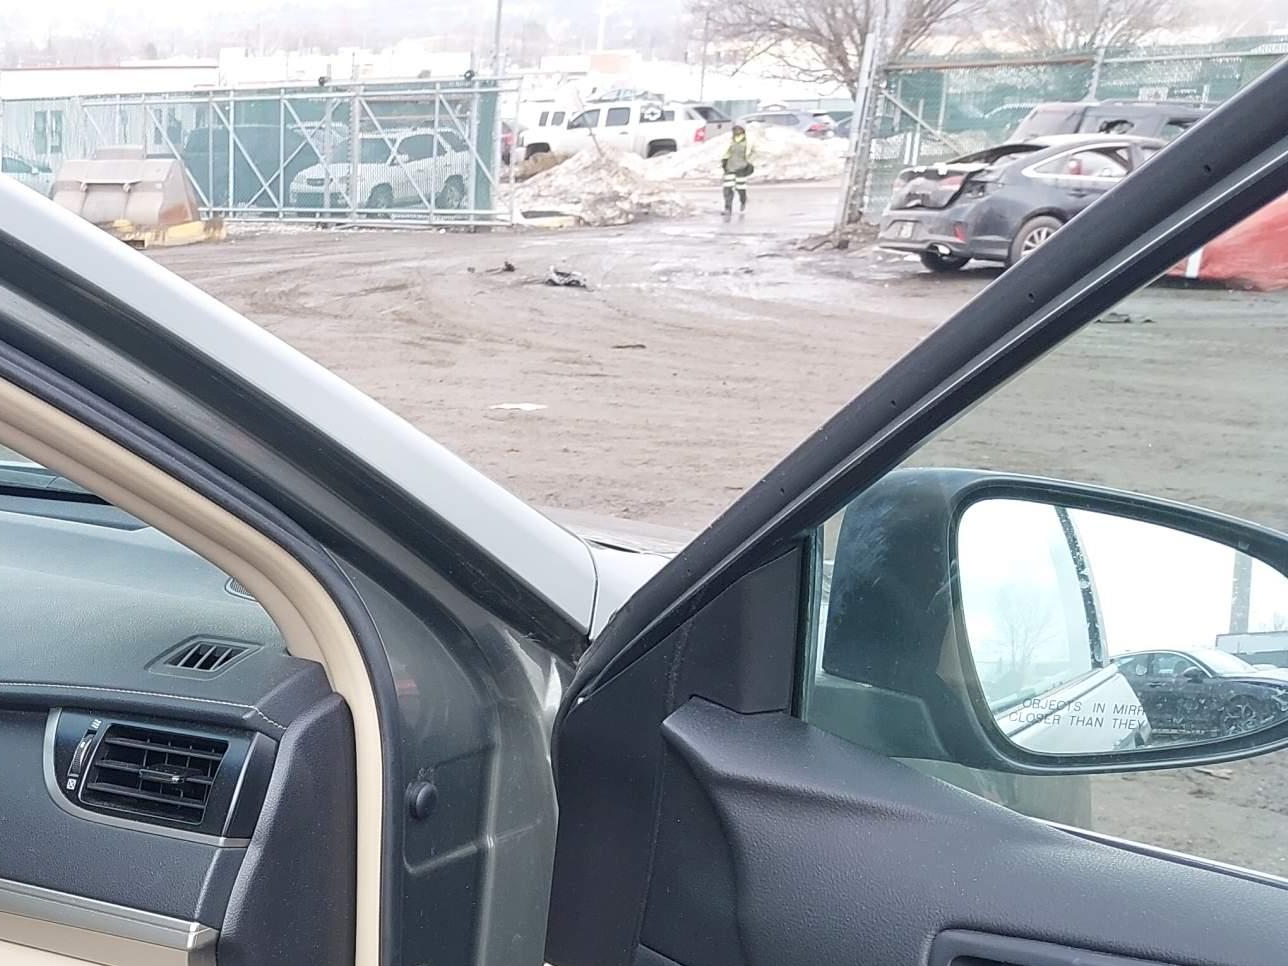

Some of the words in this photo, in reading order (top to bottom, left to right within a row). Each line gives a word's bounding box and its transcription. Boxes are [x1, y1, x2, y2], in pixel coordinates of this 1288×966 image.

[1022, 698, 1082, 712] OBJECTS
[1092, 703, 1106, 714] IN
[1008, 712, 1061, 725] CLOSER
[1069, 715, 1105, 728] THAN
[1112, 718, 1146, 730] THEY
